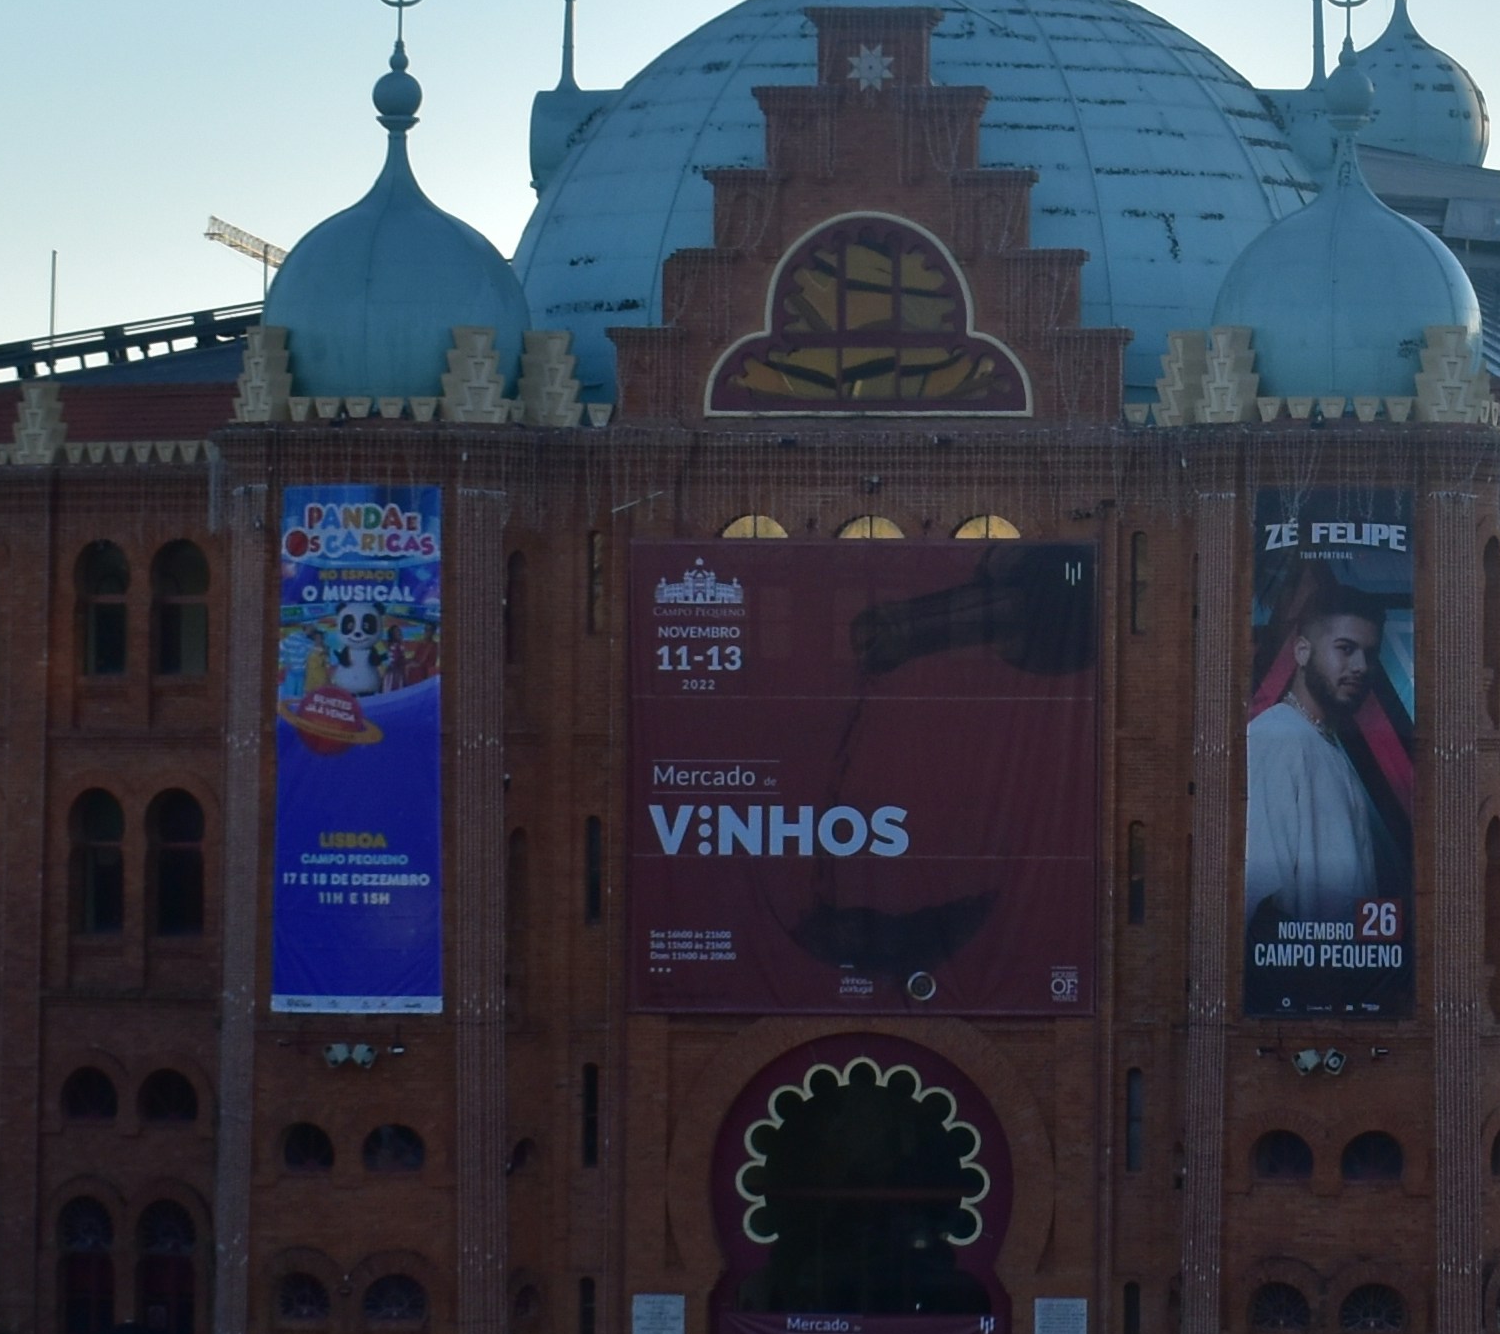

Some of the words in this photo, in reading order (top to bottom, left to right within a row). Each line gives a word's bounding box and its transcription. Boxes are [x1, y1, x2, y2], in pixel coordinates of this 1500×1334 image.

[306, 504, 404, 530] PANDA
[405, 513, 419, 531] E
[1264, 517, 1299, 551] ZÉ
[1311, 523, 1407, 552] FELIPE
[324, 531, 435, 556] CARICAS
[302, 585, 319, 602] O
[322, 584, 415, 602] MUSICAL
[653, 607, 693, 616] CAMPO
[695, 607, 746, 618] PEQUENO
[657, 626, 741, 638] NOVEMBRO
[656, 645, 742, 671] 11-13
[682, 679, 716, 690] 2022
[653, 765, 756, 786] Mercado
[763, 775, 777, 787] de
[318, 831, 388, 848] LISBOA
[300, 853, 346, 865] CAMPO
[348, 853, 409, 865] PEQUENO
[283, 872, 297, 885] 17
[300, 873, 309, 885] E
[312, 873, 328, 885] 18
[331, 873, 349, 886] DE
[351, 873, 431, 887] DEZEMBRO
[318, 892, 344, 905] 11H
[350, 892, 359, 905] E
[362, 892, 390, 906] 15H
[1278, 921, 1354, 941] NOVEMBRO
[1362, 901, 1397, 937] 26
[1254, 943, 1315, 967] CAMPO
[1320, 944, 1403, 969] PEQUENO
[786, 1318, 849, 1332] Mercado
